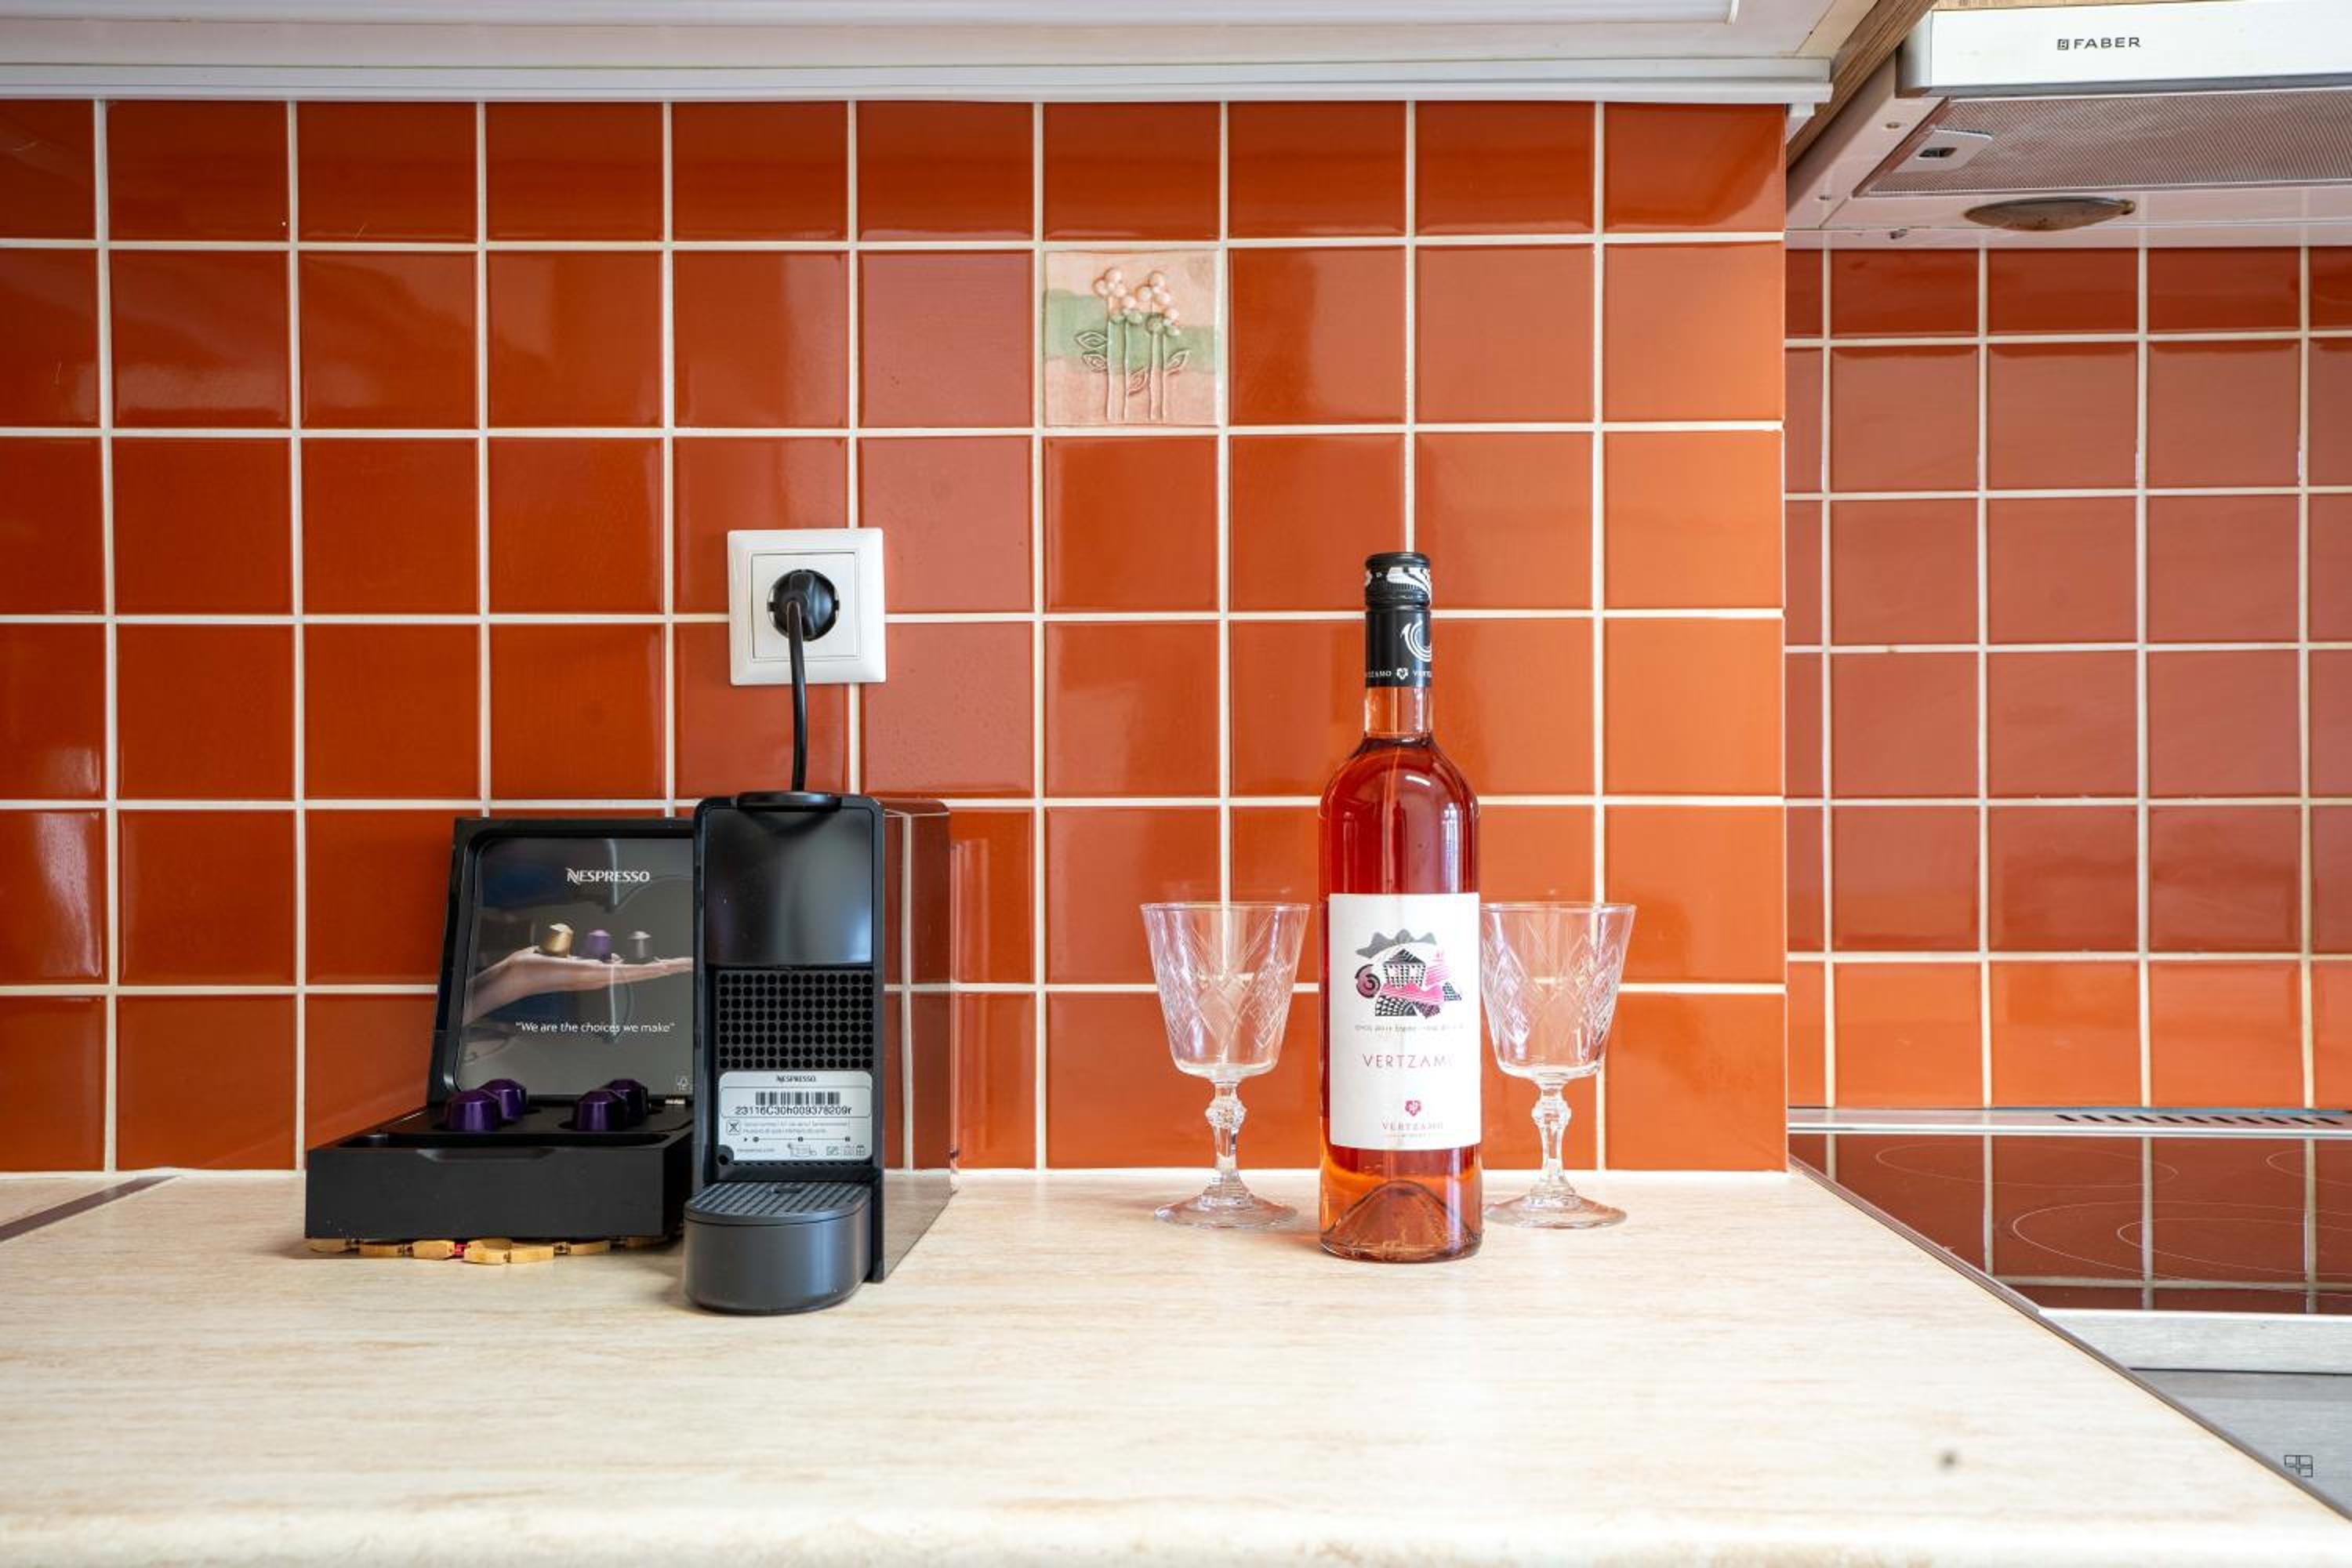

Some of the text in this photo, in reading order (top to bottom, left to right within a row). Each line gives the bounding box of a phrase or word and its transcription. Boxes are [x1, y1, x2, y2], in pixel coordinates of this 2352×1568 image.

[2074, 37, 2141, 49] FABER
[565, 867, 650, 884] NESPRESSO
[515, 1022, 539, 1033] "We
[540, 1024, 557, 1033] are
[561, 1022, 578, 1033] the
[580, 1022, 620, 1033] choices
[641, 1022, 675, 1033] make"
